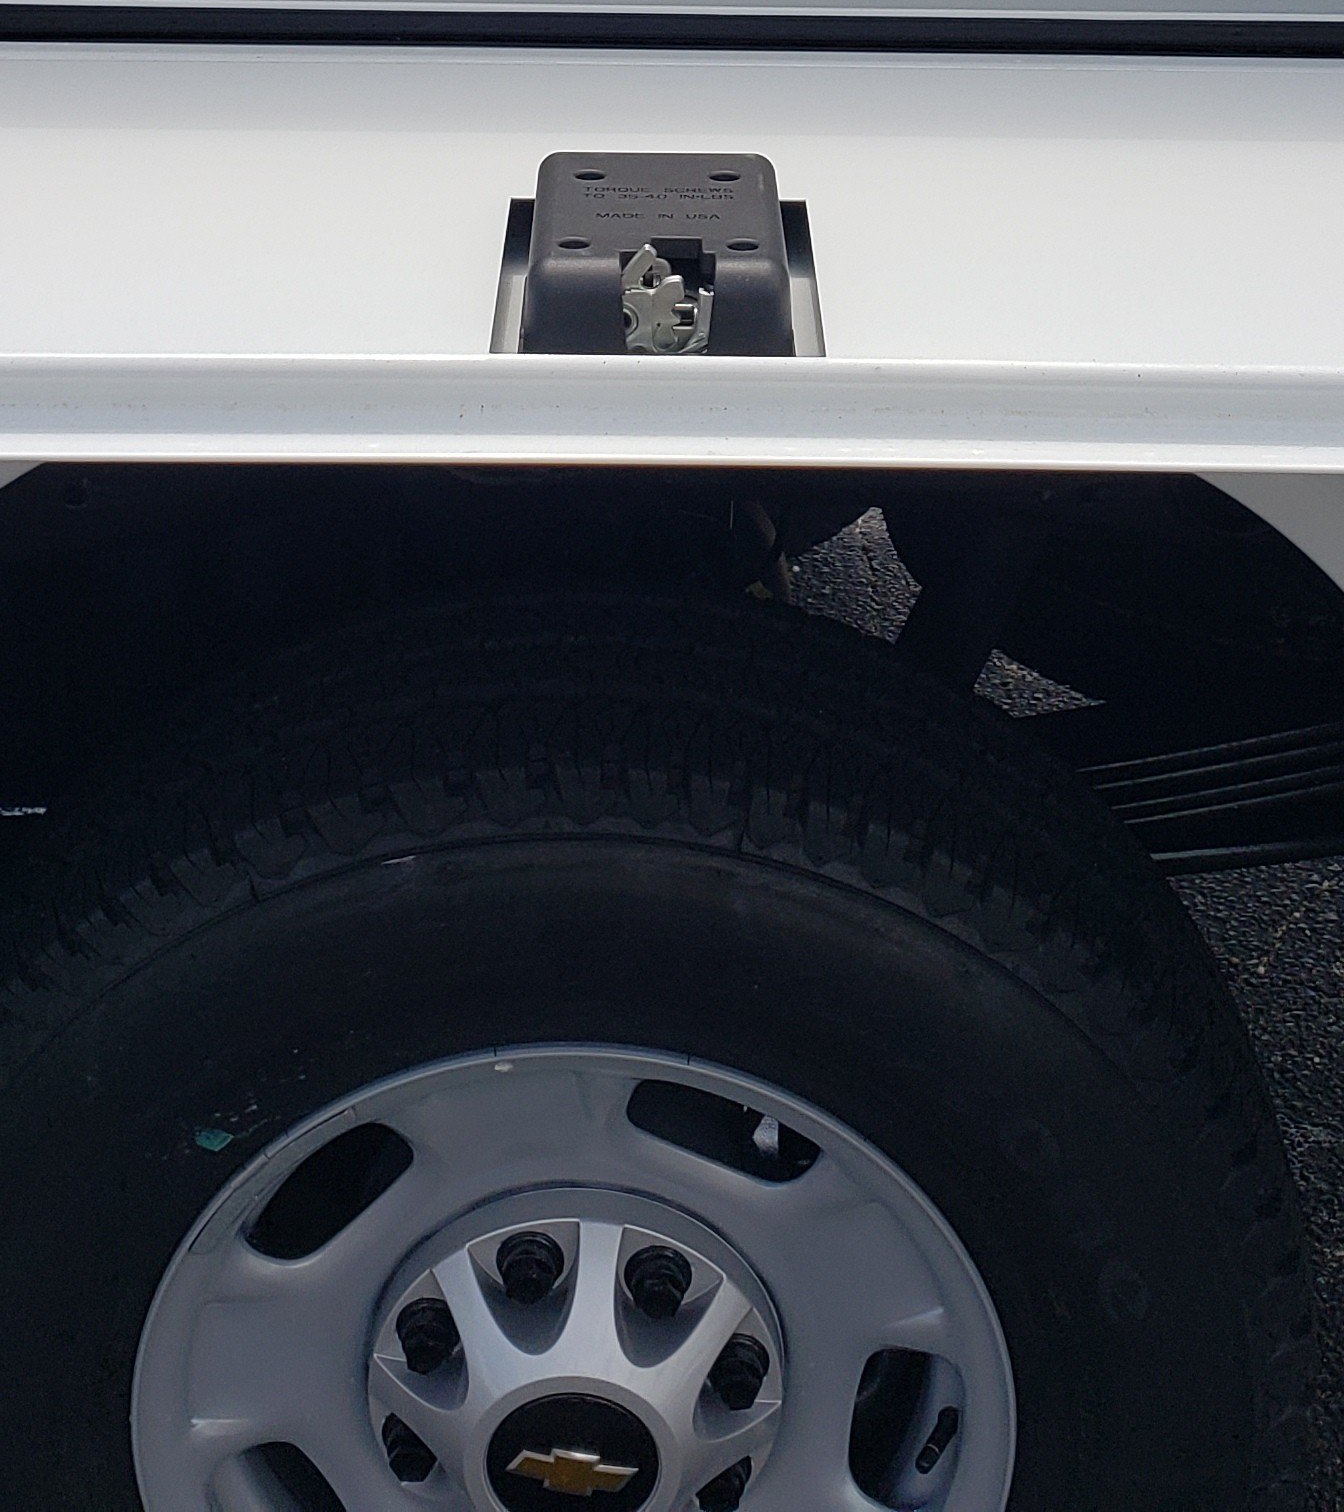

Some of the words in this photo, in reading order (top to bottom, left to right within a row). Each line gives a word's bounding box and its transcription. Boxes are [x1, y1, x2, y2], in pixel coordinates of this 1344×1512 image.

[595, 212, 646, 220] MADE
[658, 212, 674, 220] IN
[685, 212, 721, 220] USA
